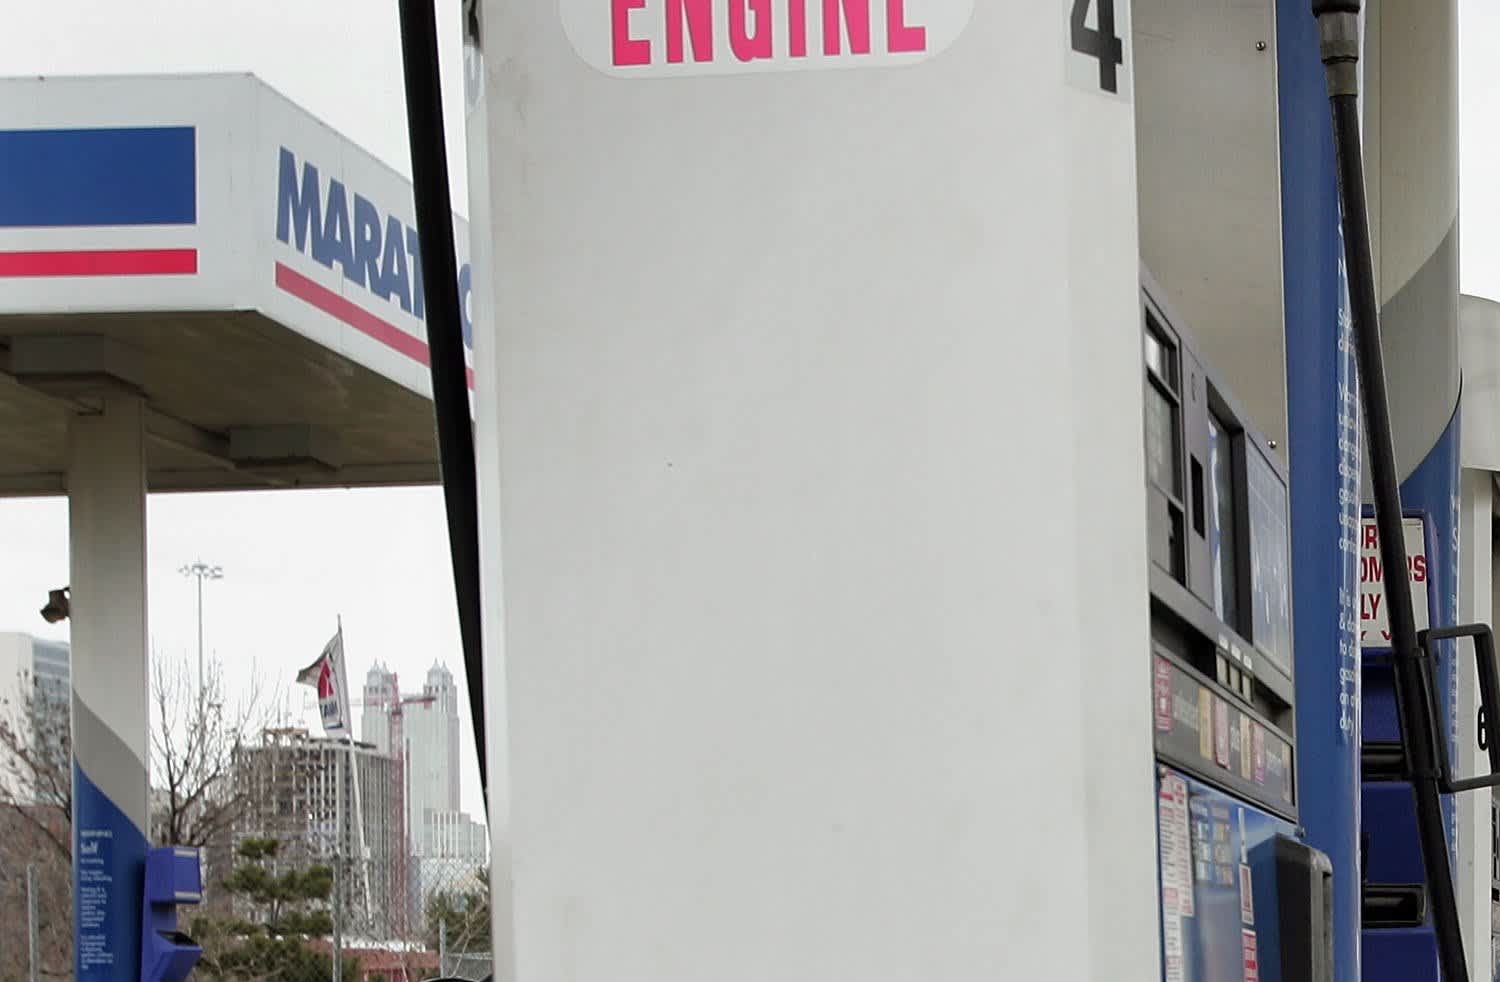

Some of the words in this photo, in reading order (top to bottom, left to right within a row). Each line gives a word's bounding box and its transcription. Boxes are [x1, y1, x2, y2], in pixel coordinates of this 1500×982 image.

[611, 0, 926, 66] ENGINE
[1070, 0, 1122, 94] 4
[276, 146, 473, 350] MARAT
